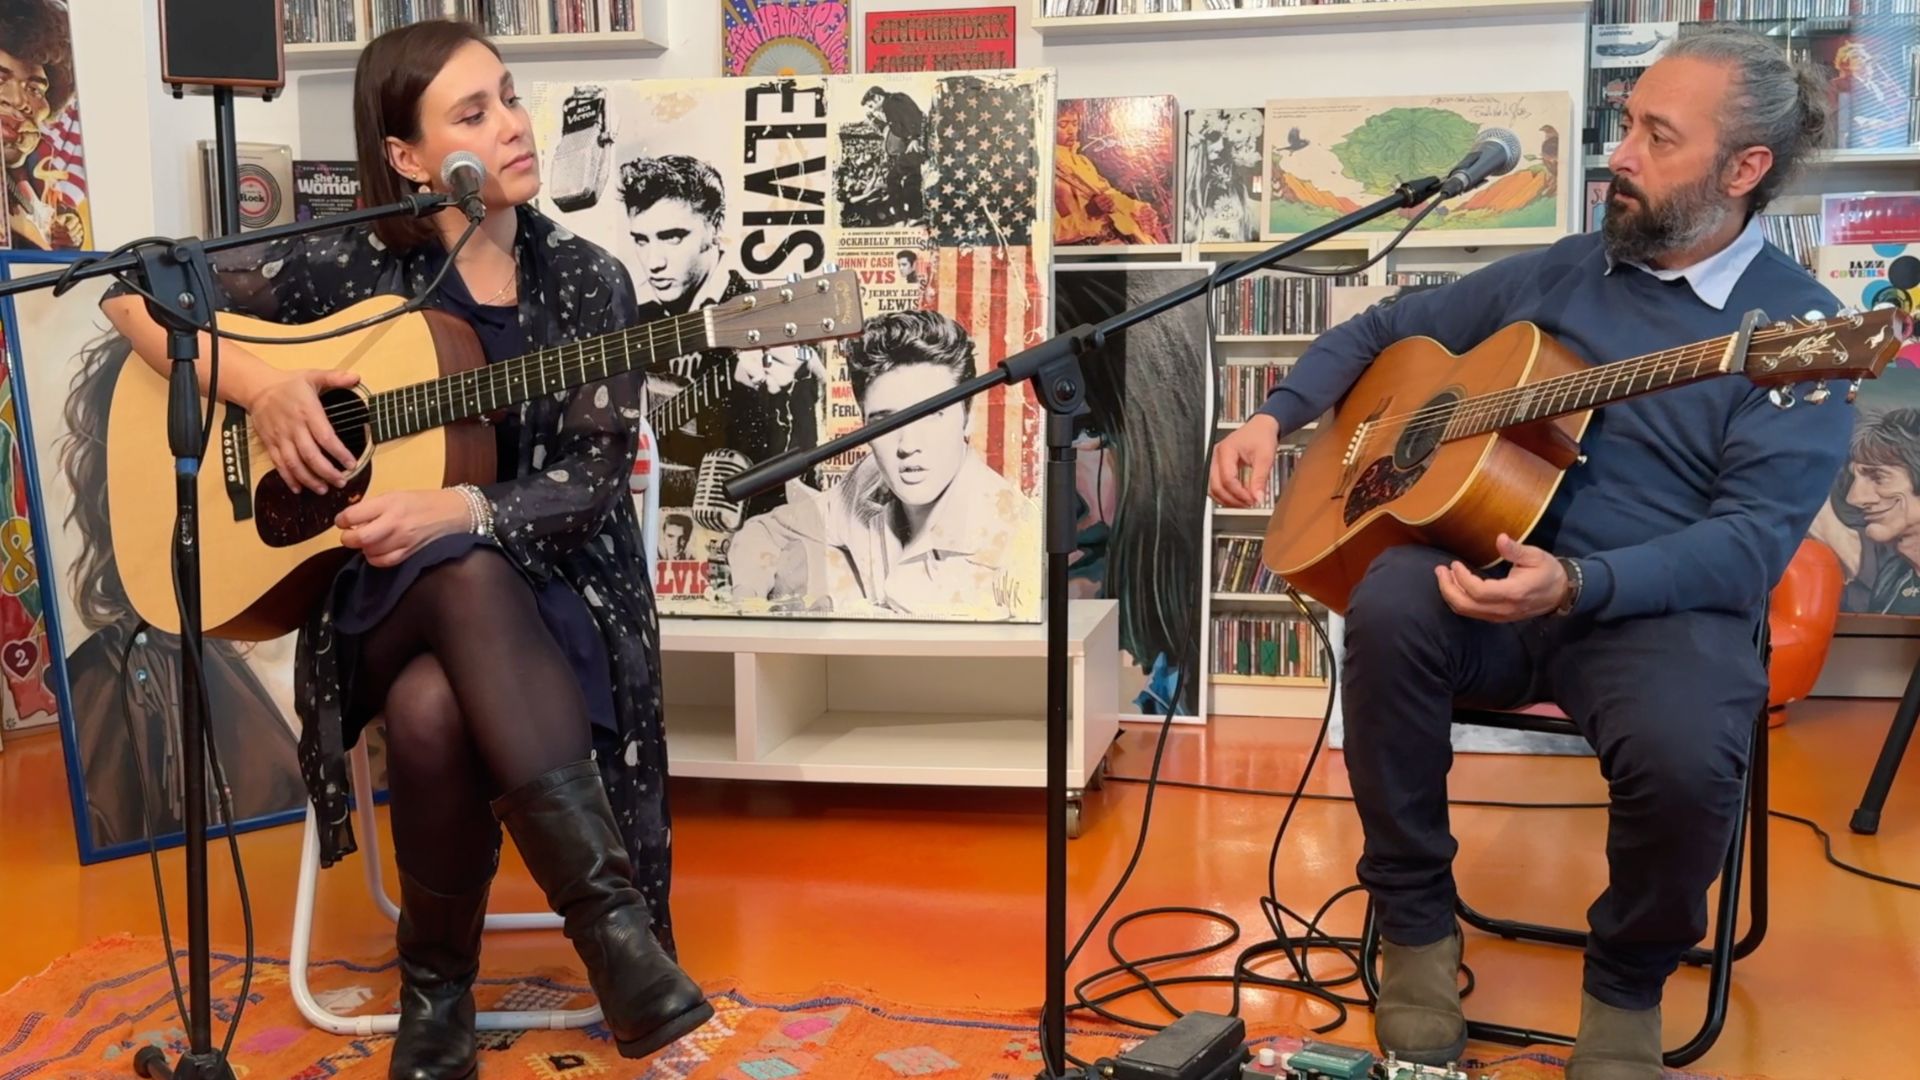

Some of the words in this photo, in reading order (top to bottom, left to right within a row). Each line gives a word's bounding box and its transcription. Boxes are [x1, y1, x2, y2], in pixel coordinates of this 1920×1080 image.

[313, 173, 341, 183] She's
[741, 79, 828, 275] ELVIS
[840, 237, 890, 246] OCKABILLY
[838, 258, 867, 268] OHNNY
[870, 257, 894, 268] CASH
[1850, 261, 1885, 269] JAZZ
[859, 270, 896, 284] VIS
[1830, 269, 1886, 278] COVERS
[869, 290, 899, 298] JERRY
[901, 289, 919, 297] LEE
[879, 299, 920, 311] LEWIS
[831, 404, 860, 418] FERL
[656, 562, 710, 594] LVIS
[15, 650, 29, 668] 2
